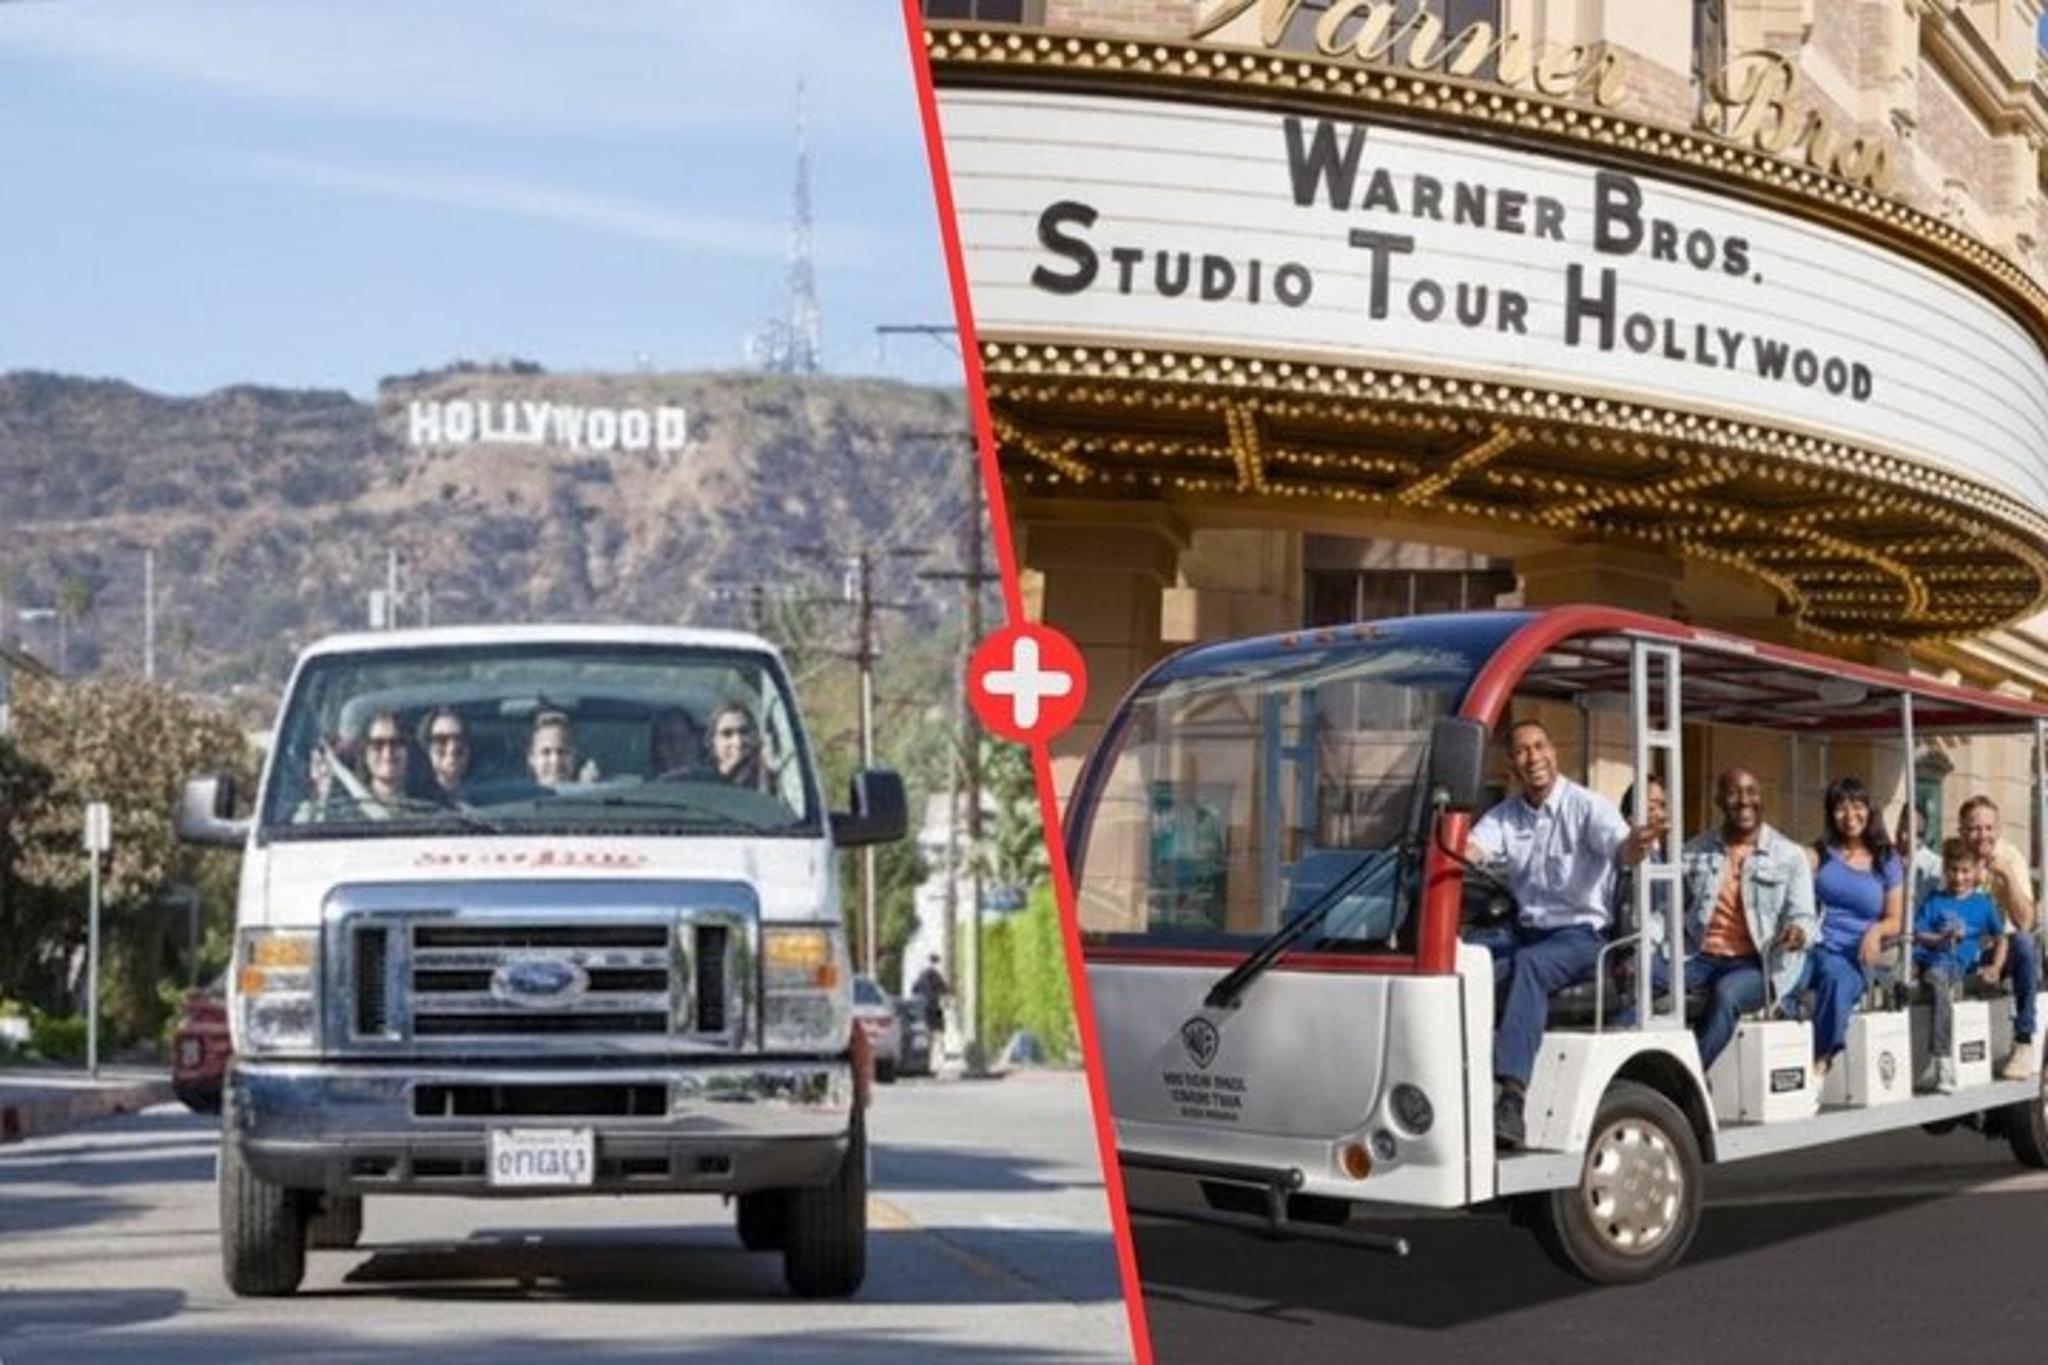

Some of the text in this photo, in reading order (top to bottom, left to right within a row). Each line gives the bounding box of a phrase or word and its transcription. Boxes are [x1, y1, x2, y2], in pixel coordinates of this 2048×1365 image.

[1283, 115, 1763, 285] WARNER BROS.
[1030, 200, 1874, 402] STUDIO TOUR HOLLYWOOD
[409, 399, 687, 452] HOLLYWOOD
